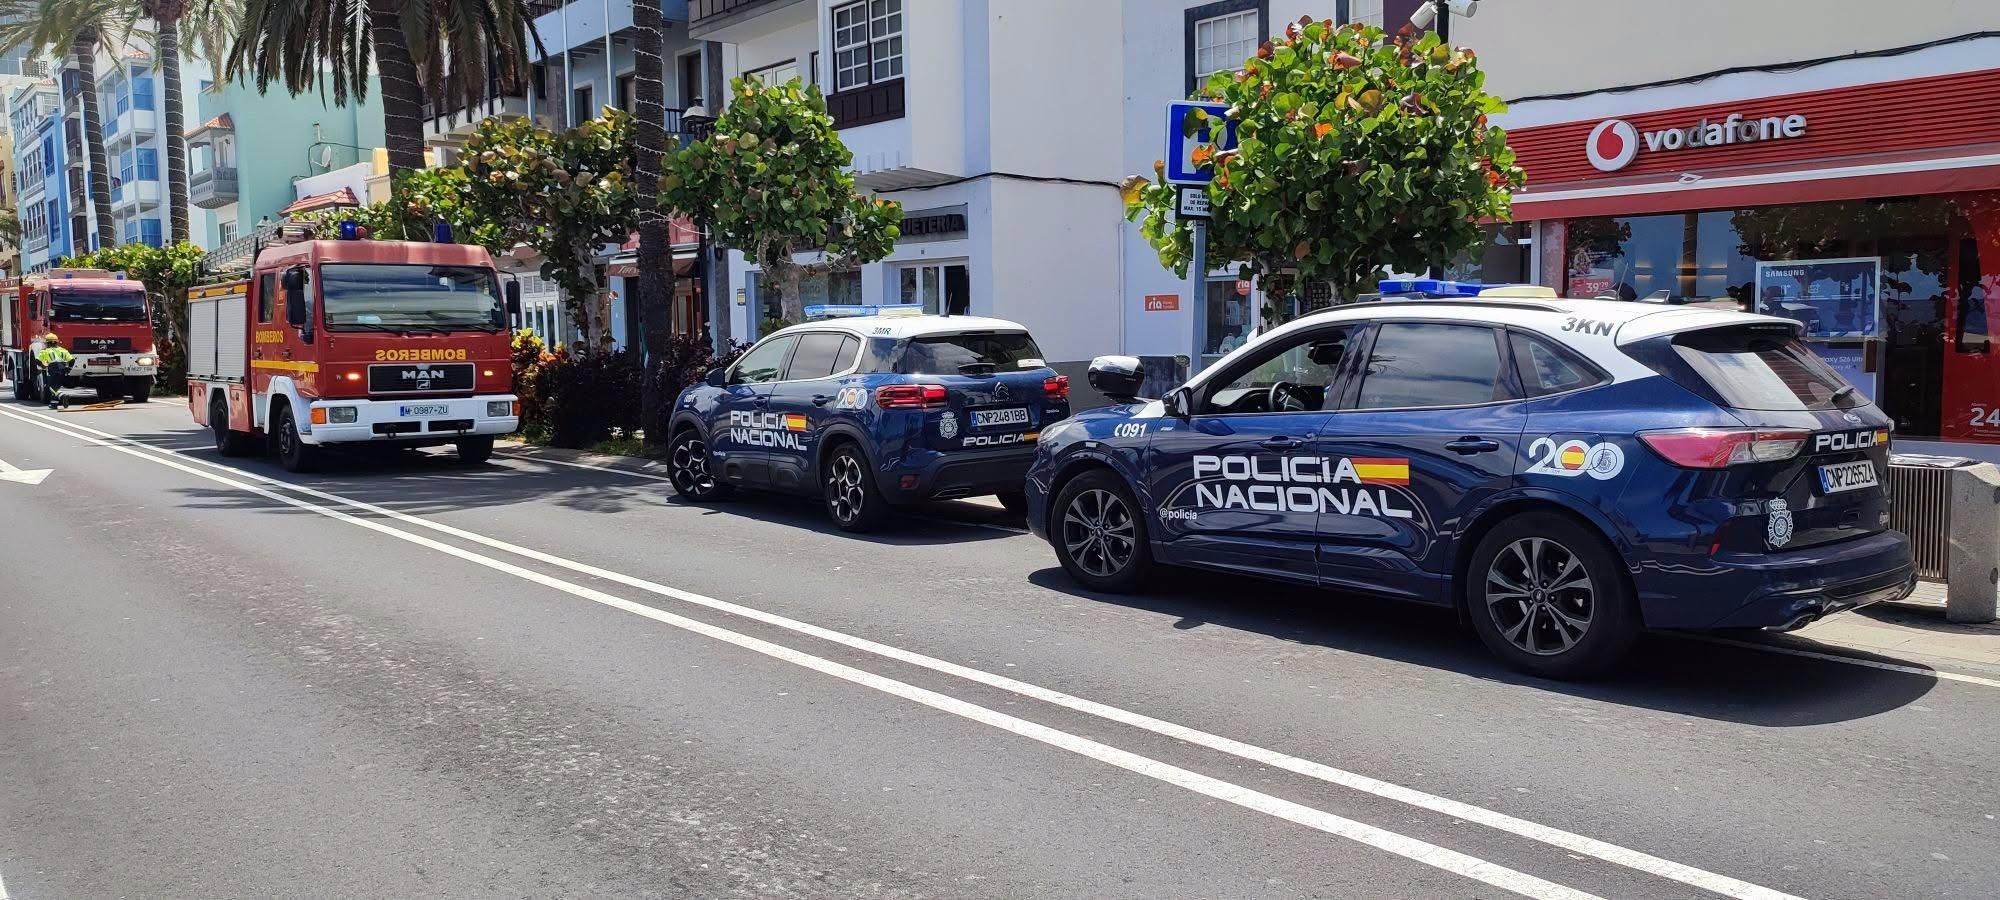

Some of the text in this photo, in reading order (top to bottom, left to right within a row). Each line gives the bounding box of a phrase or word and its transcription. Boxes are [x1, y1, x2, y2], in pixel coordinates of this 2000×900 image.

[1644, 113, 1806, 152] vodafone
[901, 214, 964, 235] UETERIA
[1765, 269, 1805, 278] SAMSUNG
[1236, 280, 1250, 288] ria
[1148, 297, 1162, 310] ria
[872, 327, 892, 335] 3MR
[1561, 317, 1614, 336] 3KN
[255, 331, 284, 343] BOMBEROS
[402, 370, 445, 379] MAN
[835, 388, 868, 410] 200
[976, 409, 1026, 424] CNP2481BB
[1121, 423, 1147, 437] 091
[731, 428, 807, 451] NACIONAL
[1525, 437, 1625, 480] 200
[1826, 463, 1876, 489] CNP2265ZA
[1196, 484, 1412, 519] NACIONAL
